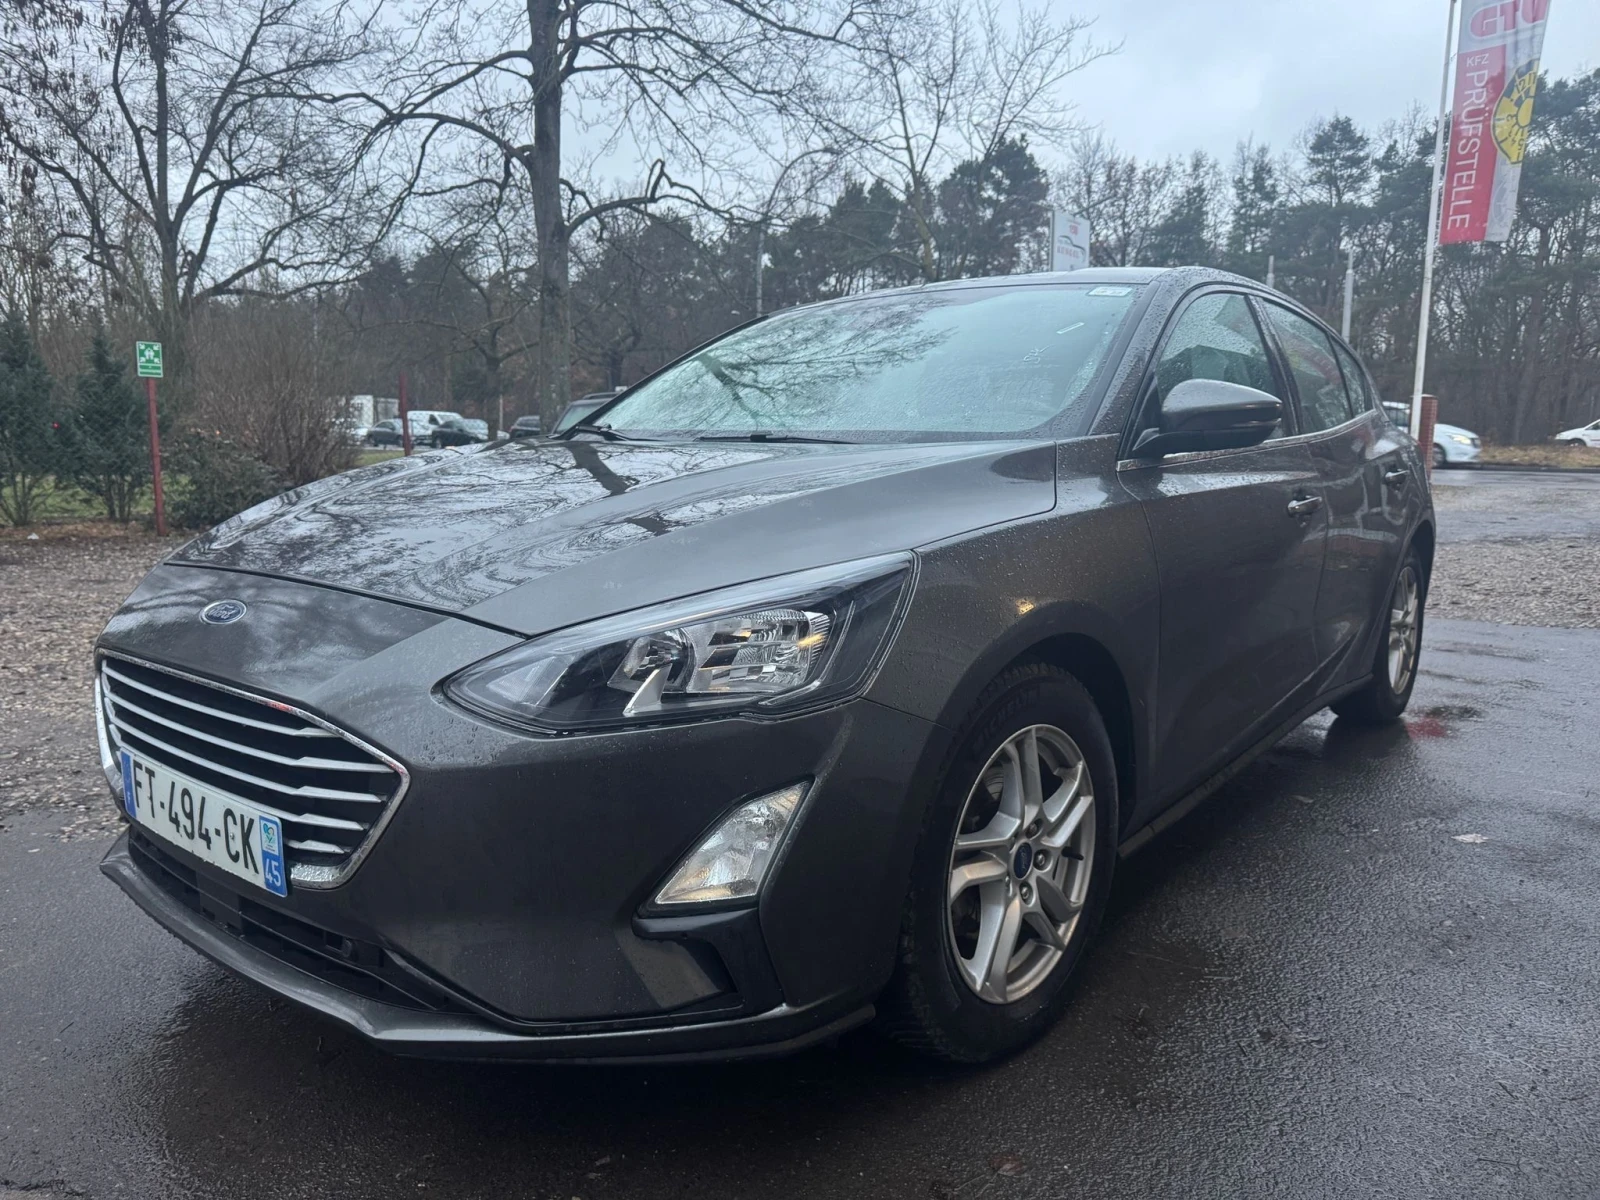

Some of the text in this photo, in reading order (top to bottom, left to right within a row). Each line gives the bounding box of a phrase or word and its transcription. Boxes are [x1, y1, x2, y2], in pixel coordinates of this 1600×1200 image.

[1466, 53, 1489, 67] KFZ
[1447, 70, 1489, 230] PRÜFSTELLE
[133, 760, 259, 874] FT-494-CK
[265, 858, 281, 887] 45
